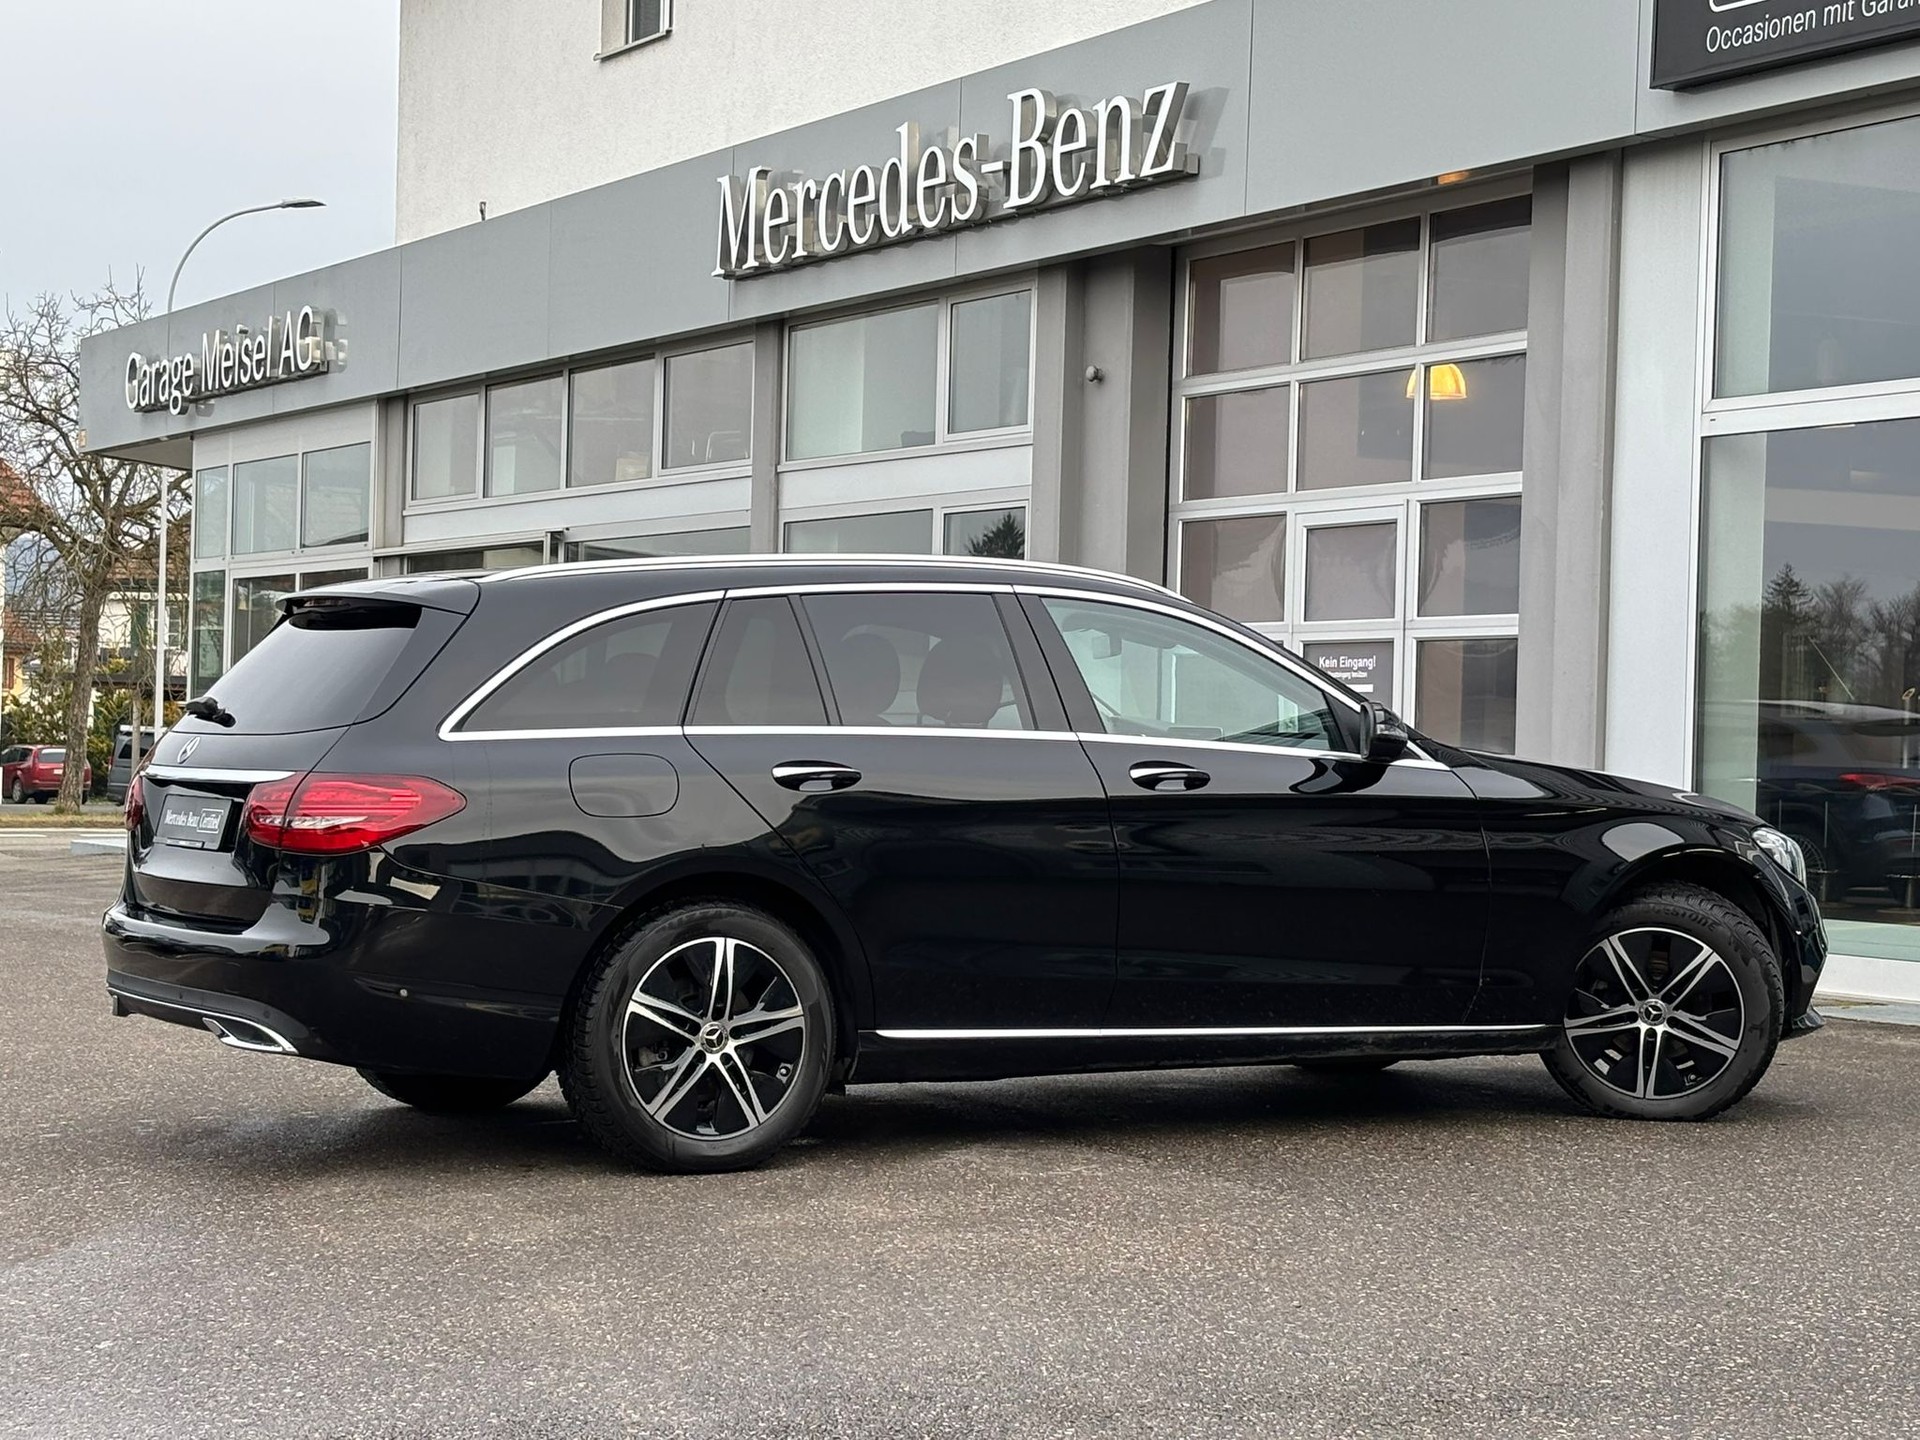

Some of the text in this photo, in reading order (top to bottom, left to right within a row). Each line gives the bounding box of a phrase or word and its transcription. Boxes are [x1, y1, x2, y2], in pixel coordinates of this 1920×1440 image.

[1705, 10, 1816, 53] Occasionen
[1823, 0, 1855, 26] mit
[711, 81, 1189, 277] Mercedes-Benz
[125, 305, 316, 415] Garage Meisel AG
[1319, 655, 1376, 671] Kein Eingang!
